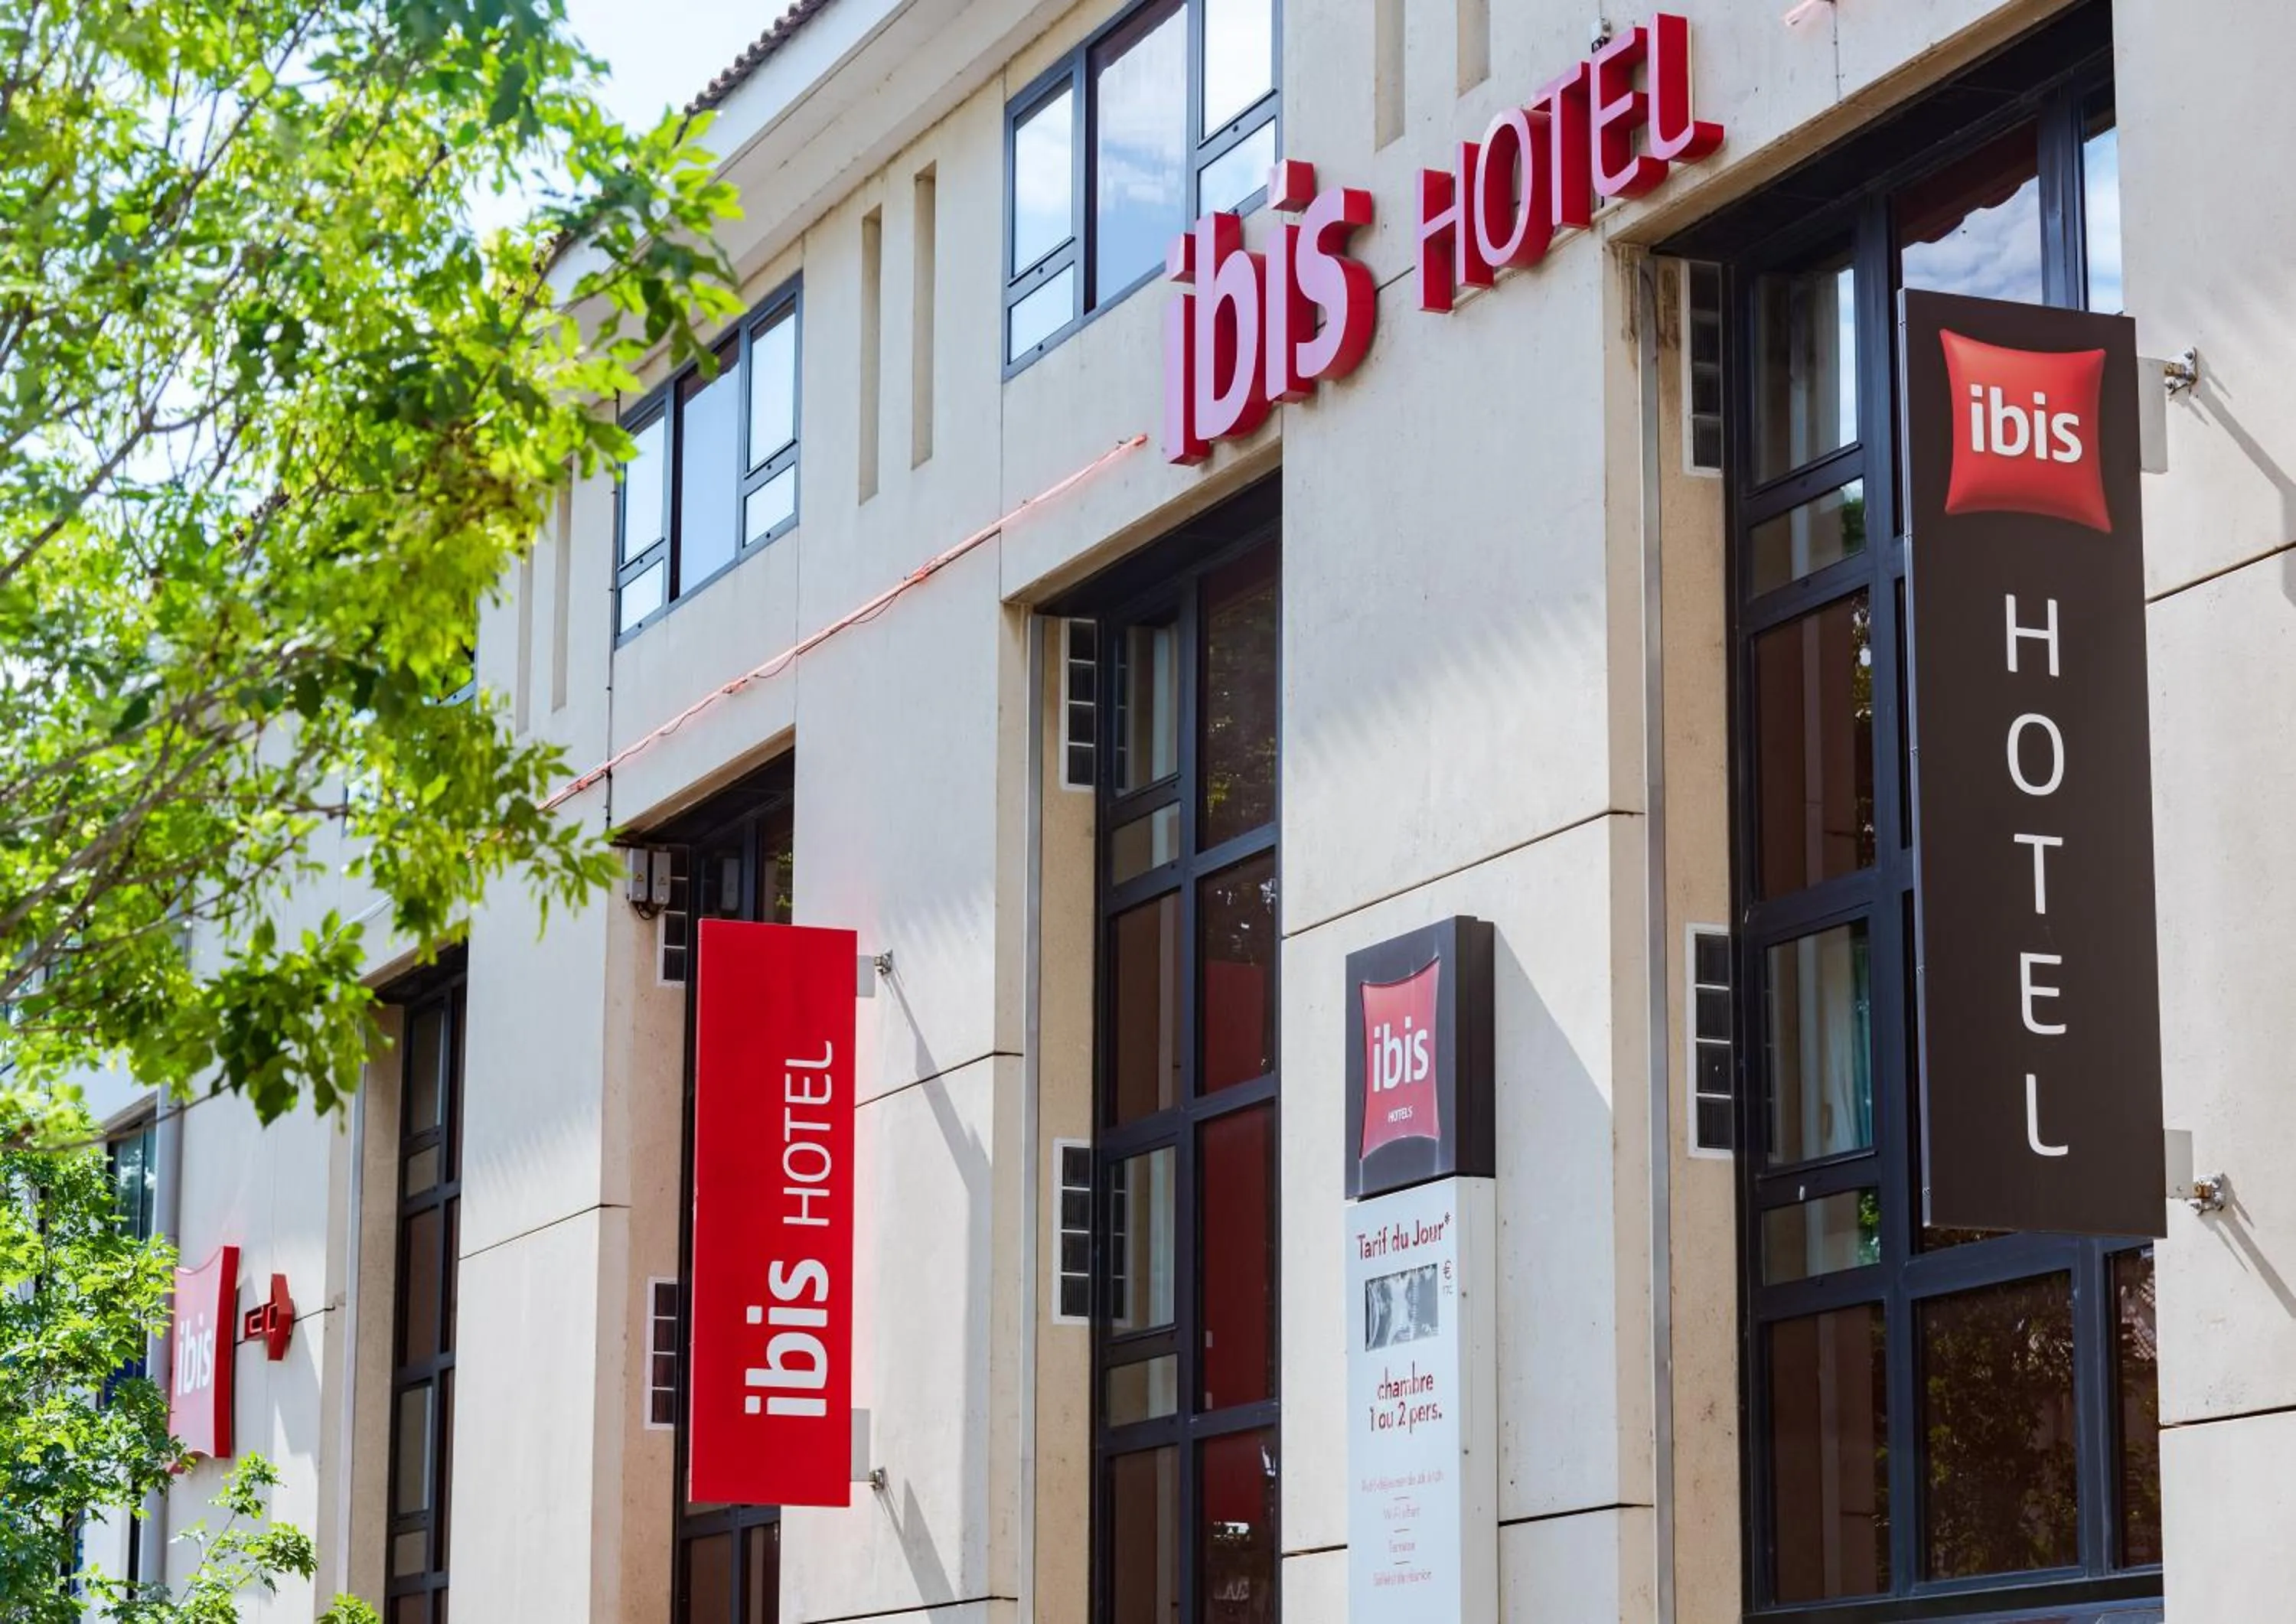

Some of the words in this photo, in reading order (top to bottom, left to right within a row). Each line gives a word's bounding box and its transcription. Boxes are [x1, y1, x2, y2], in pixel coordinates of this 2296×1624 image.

[1165, 158, 1376, 466] ibis
[1415, 13, 1724, 314] HOTEL
[1970, 383, 2082, 463] ibis
[2005, 593, 2069, 1157] HOTEL
[1373, 1016, 1429, 1092] ibis
[782, 1040, 833, 1227] HOTEL
[1356, 1226, 1388, 1260] Tarif
[1392, 1223, 1410, 1252] du
[177, 1313, 213, 1397] ibis
[745, 1258, 830, 1417] ibis
[1369, 1406, 1375, 1432] 1
[1378, 1411, 1394, 1429] ou
[1397, 1401, 1407, 1426] 2
[1409, 1403, 1443, 1433] pers.
[1377, 1360, 1434, 1400] chambre
